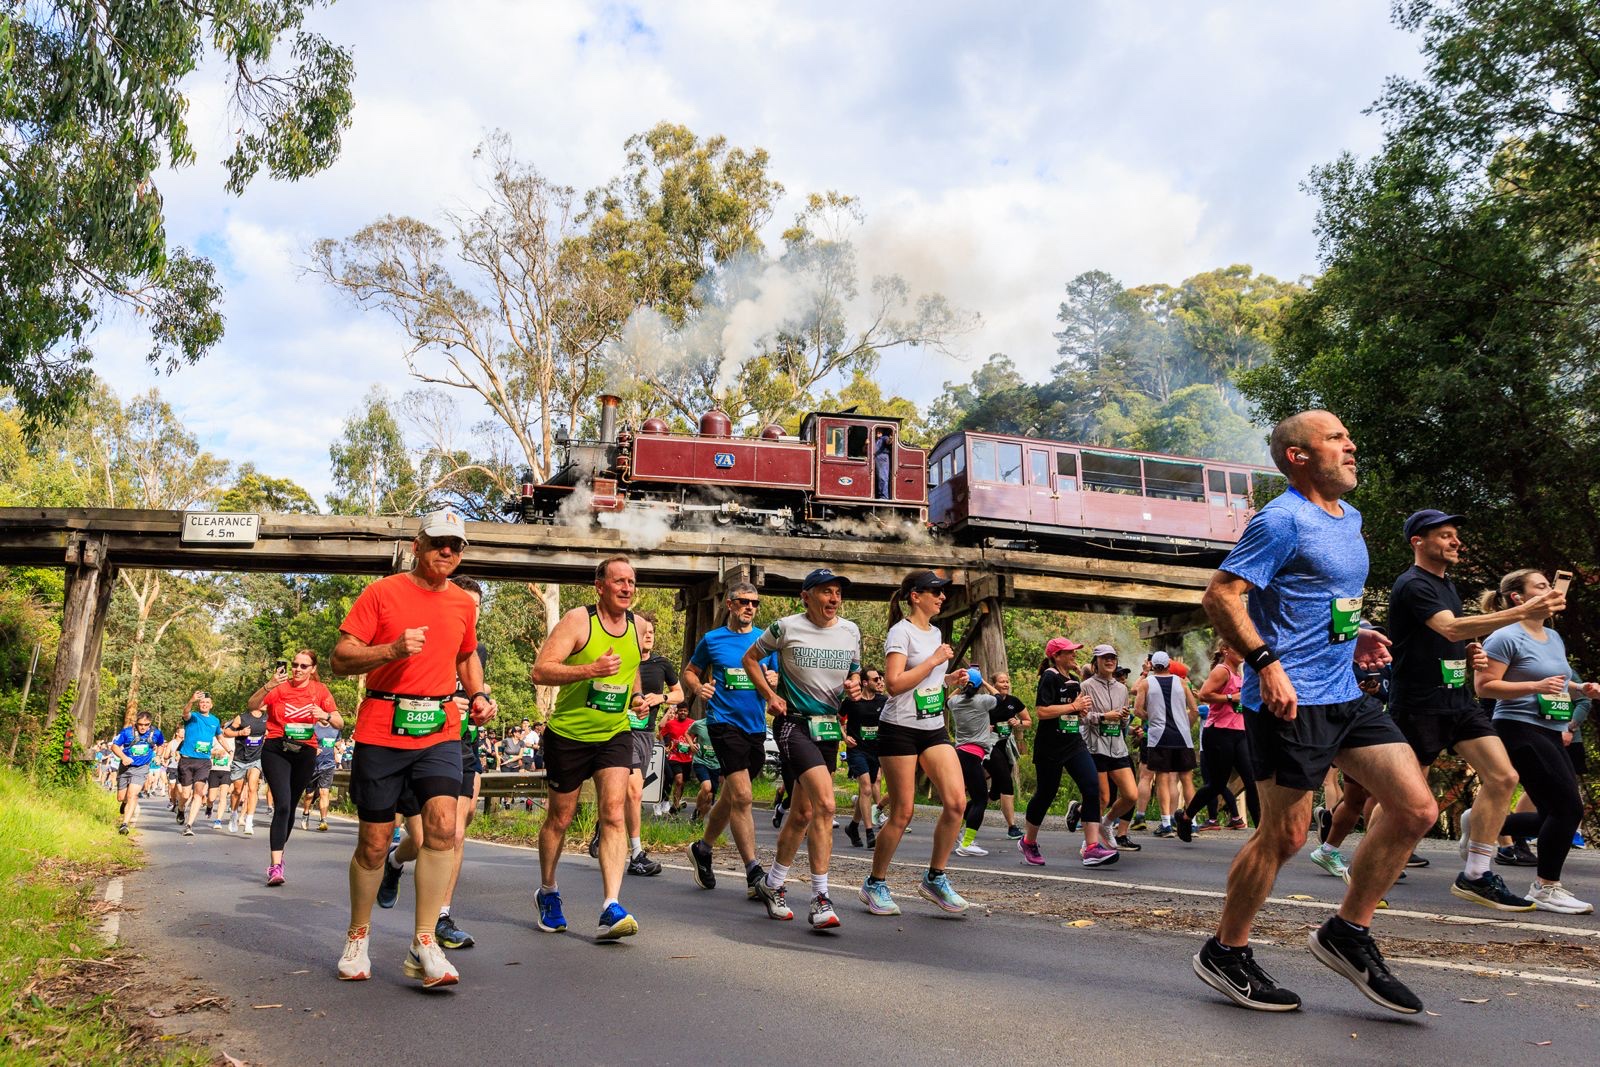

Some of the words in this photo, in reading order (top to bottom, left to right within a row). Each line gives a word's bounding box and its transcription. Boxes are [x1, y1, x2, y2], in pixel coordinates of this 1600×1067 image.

[717, 454, 732, 465] 7A
[191, 516, 253, 527] CLEARANCE
[206, 529, 235, 538] 4.5m
[793, 646, 844, 660] RUNNING
[795, 656, 818, 668] THE
[605, 693, 617, 702] 42
[406, 711, 435, 722] 8494
